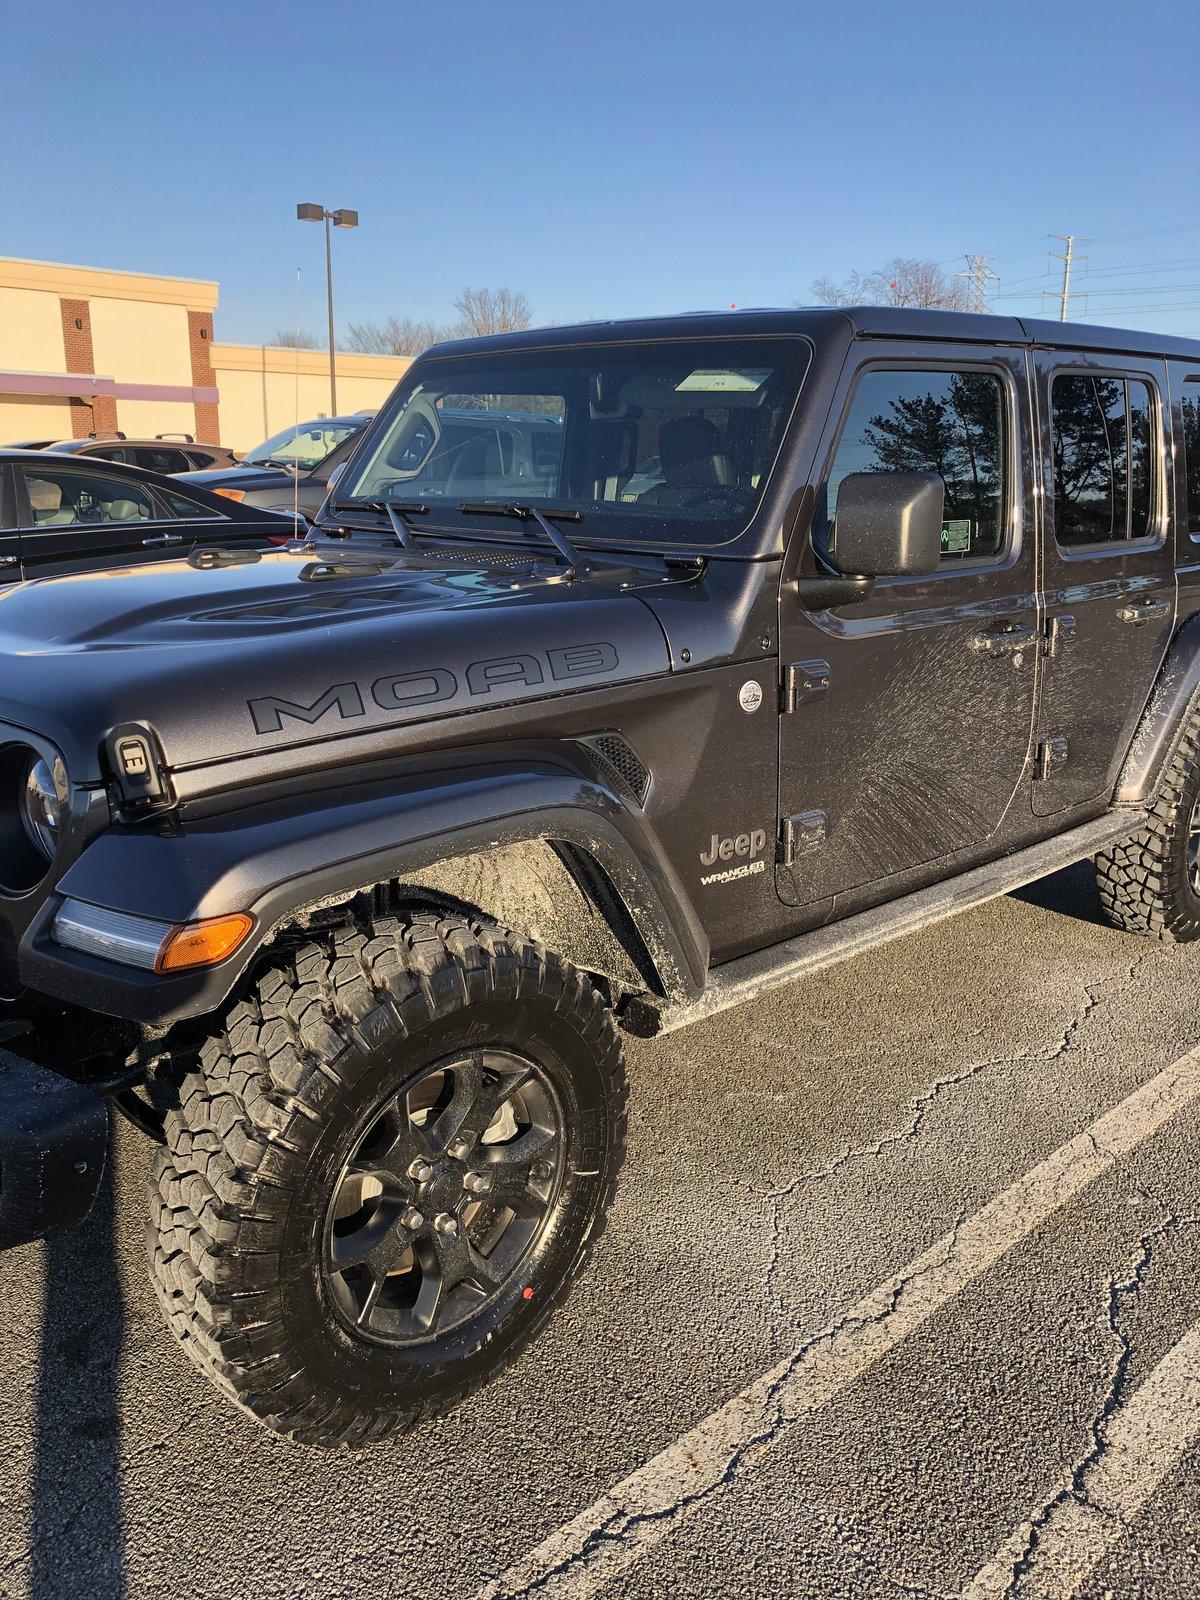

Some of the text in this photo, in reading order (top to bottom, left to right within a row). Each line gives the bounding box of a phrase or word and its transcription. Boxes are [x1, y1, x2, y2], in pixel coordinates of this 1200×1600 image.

[246, 641, 620, 735] MOAB
[700, 828, 766, 866] Jeep
[700, 860, 765, 886] WRANGLER
